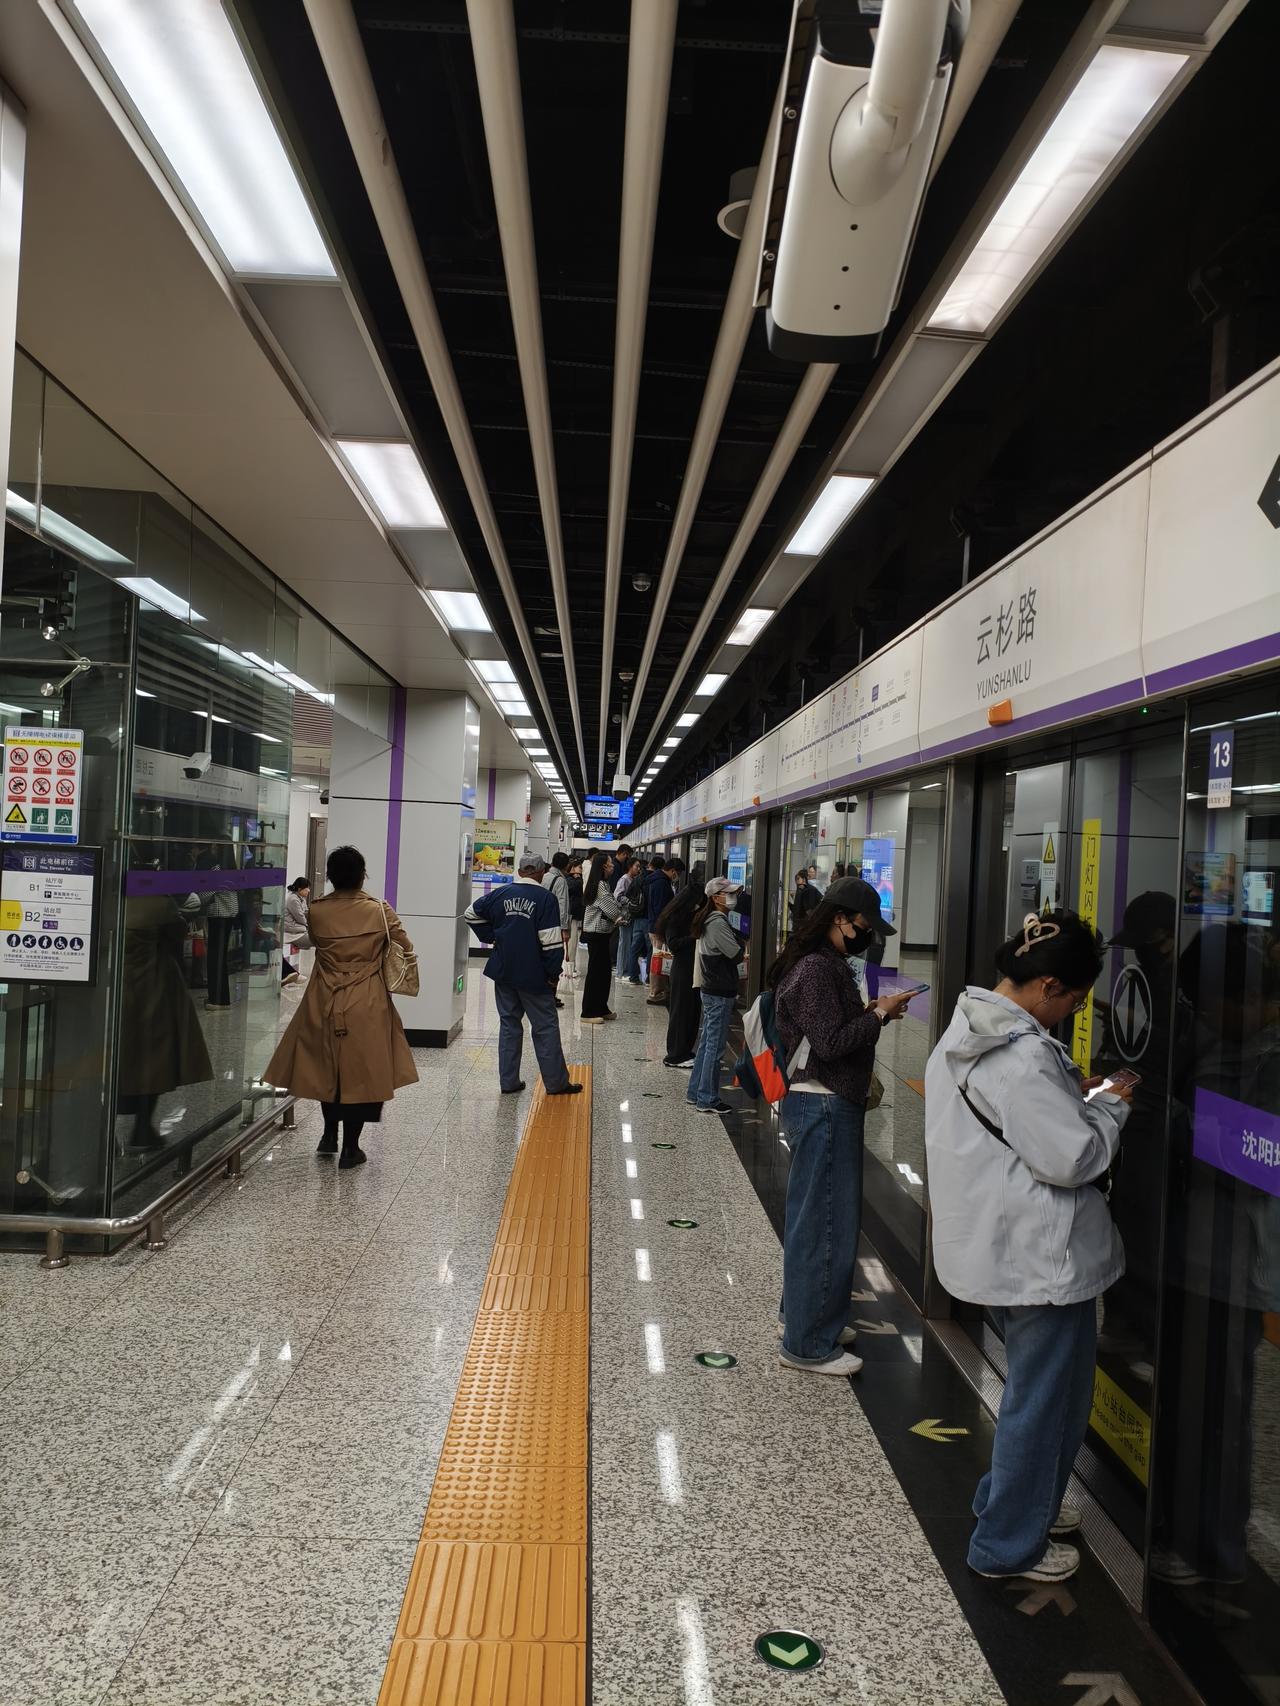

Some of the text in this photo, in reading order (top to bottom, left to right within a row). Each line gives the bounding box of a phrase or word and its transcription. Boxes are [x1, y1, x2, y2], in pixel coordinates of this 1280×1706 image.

[977, 586, 1037, 665] 云杉路
[976, 658, 1032, 700] YUNSHANLU
[1213, 741, 1230, 767] 13
[29, 883, 40, 892] B1
[25, 911, 41, 922] B2
